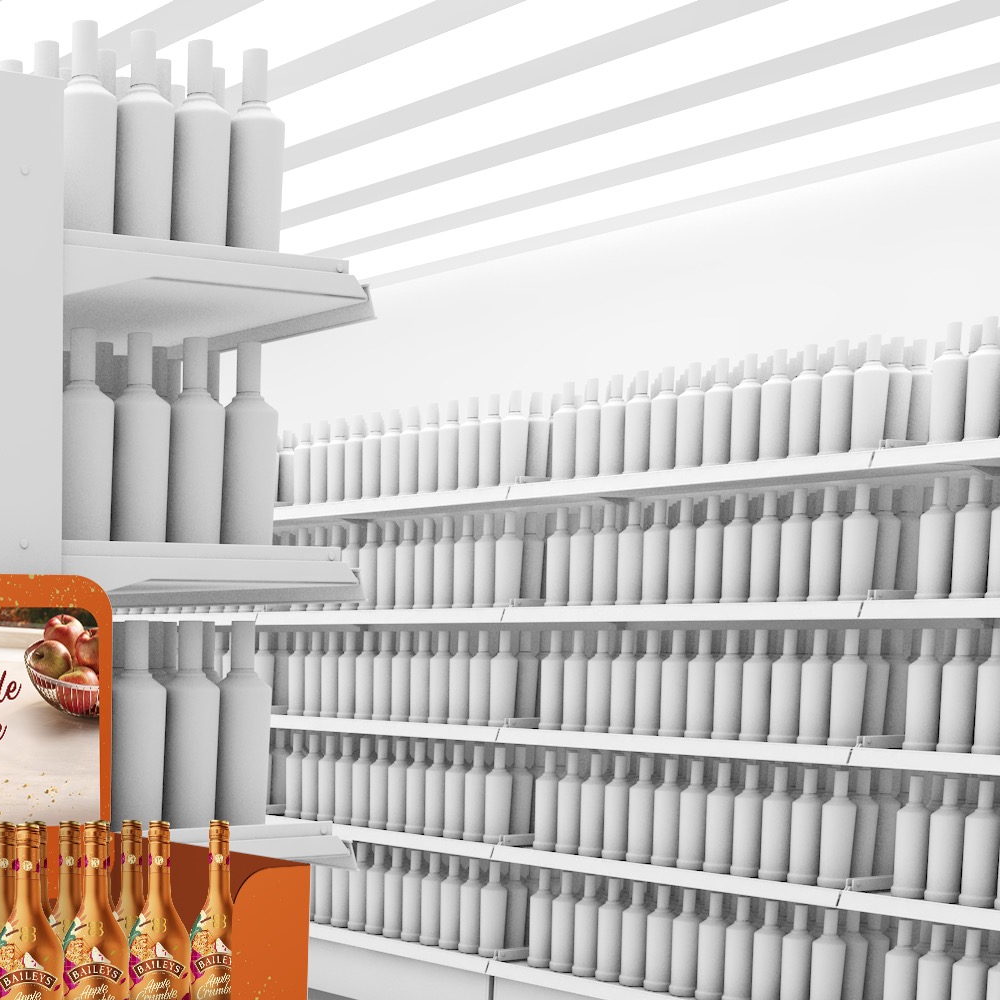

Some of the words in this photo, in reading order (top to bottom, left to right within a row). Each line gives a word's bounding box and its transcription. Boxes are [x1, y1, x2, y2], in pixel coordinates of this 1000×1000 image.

[72, 965, 119, 980] BAILEYS
[137, 960, 182, 974] BAILEYS
[2, 971, 53, 987] BAILEYS
[145, 978, 171, 993] Apple
[81, 983, 109, 1000] Apple
